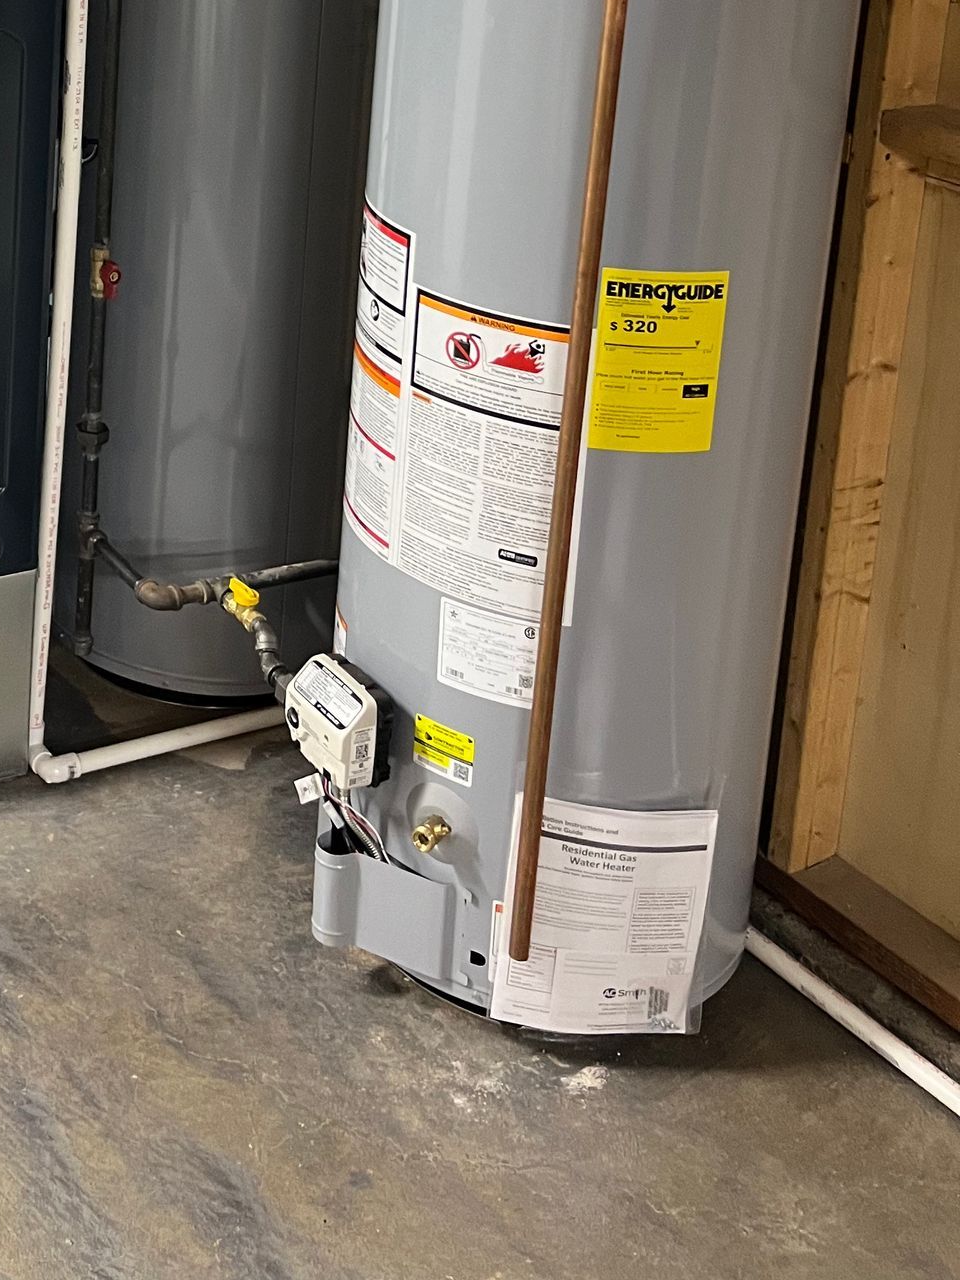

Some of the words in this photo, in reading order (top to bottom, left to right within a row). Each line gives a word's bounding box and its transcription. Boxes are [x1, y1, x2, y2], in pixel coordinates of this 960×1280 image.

[606, 280, 725, 302] ENERGYGUIDE
[478, 317, 515, 332] WARNING
[623, 320, 657, 333] 320
[547, 823, 561, 832] Care
[563, 827, 583, 836] Guide
[565, 820, 604, 833] Instructions
[561, 844, 616, 860] Residential
[619, 853, 637, 862] Gas
[569, 856, 600, 869] Water
[603, 862, 636, 872] Heater
